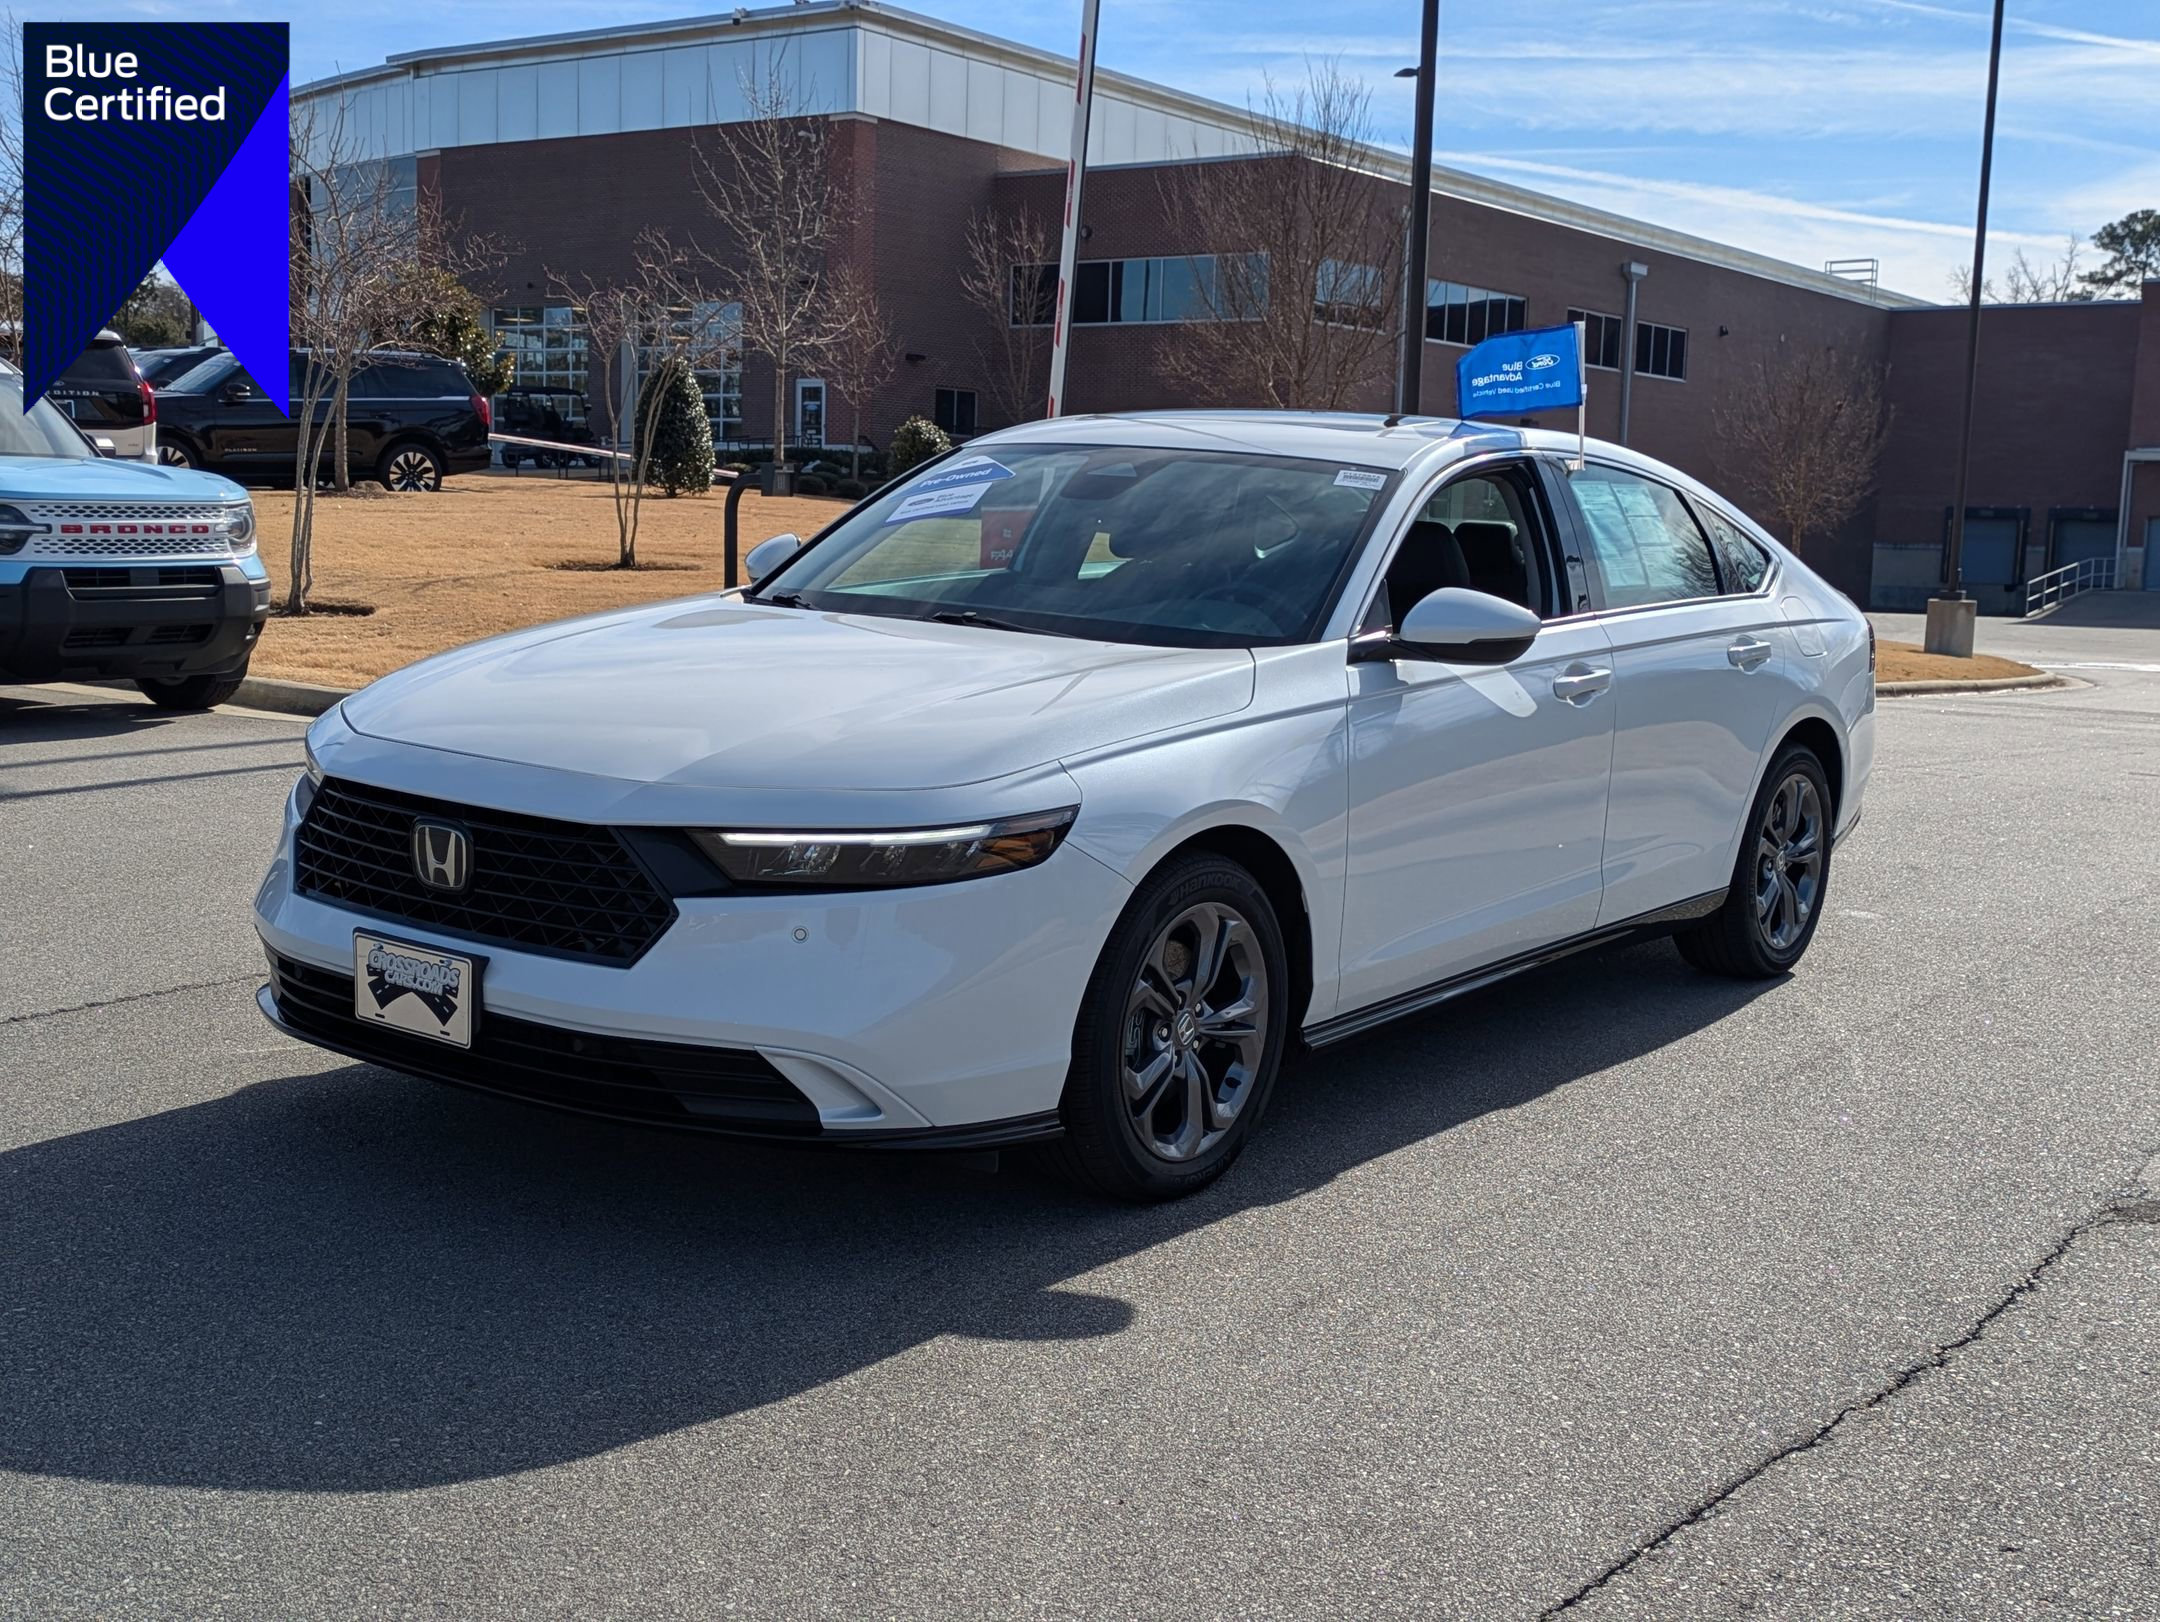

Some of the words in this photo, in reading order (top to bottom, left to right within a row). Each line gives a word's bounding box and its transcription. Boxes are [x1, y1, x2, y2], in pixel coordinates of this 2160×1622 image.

[919, 467, 993, 488] Pre-Owned
[60, 524, 209, 534] BRONCO
[367, 948, 461, 988] CROSSROADS
[385, 971, 443, 996] CARS.COM
